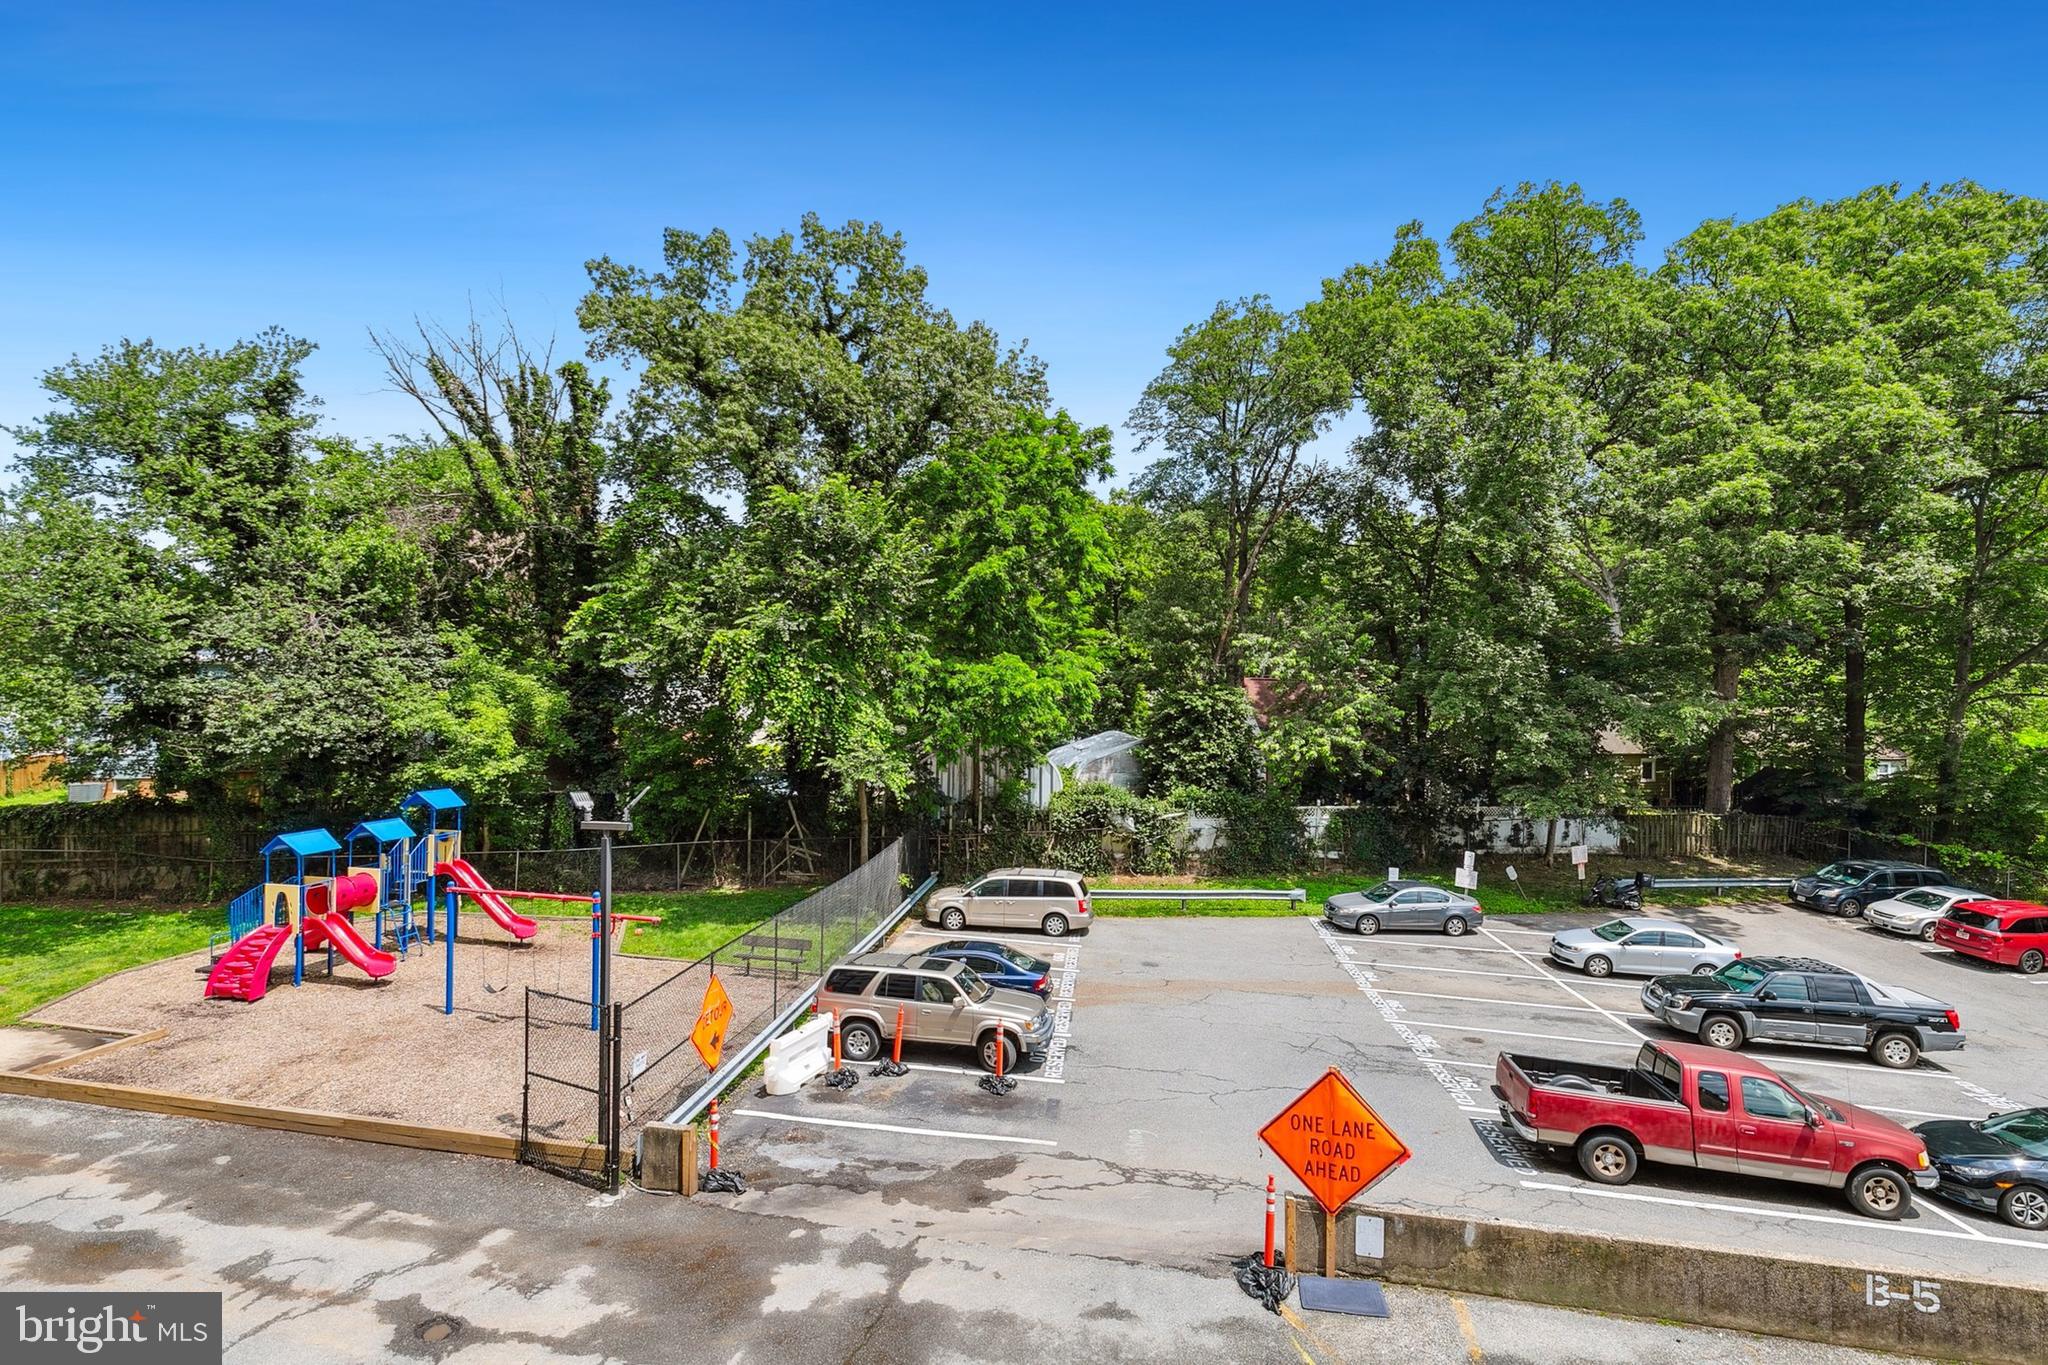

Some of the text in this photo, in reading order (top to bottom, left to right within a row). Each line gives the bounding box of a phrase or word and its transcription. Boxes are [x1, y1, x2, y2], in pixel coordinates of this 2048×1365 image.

[1044, 1037, 1067, 1078] RESERVED
[1390, 1023, 1433, 1058] RESERVED
[1423, 1062, 1476, 1106] RESERVED
[1290, 1114, 1376, 1140] ONE LANE
[1310, 1138, 1355, 1160] ROAD
[1473, 1119, 1538, 1176] RESERVED
[1304, 1160, 1361, 1183] AHEAD
[1866, 1274, 1941, 1313] B-5
